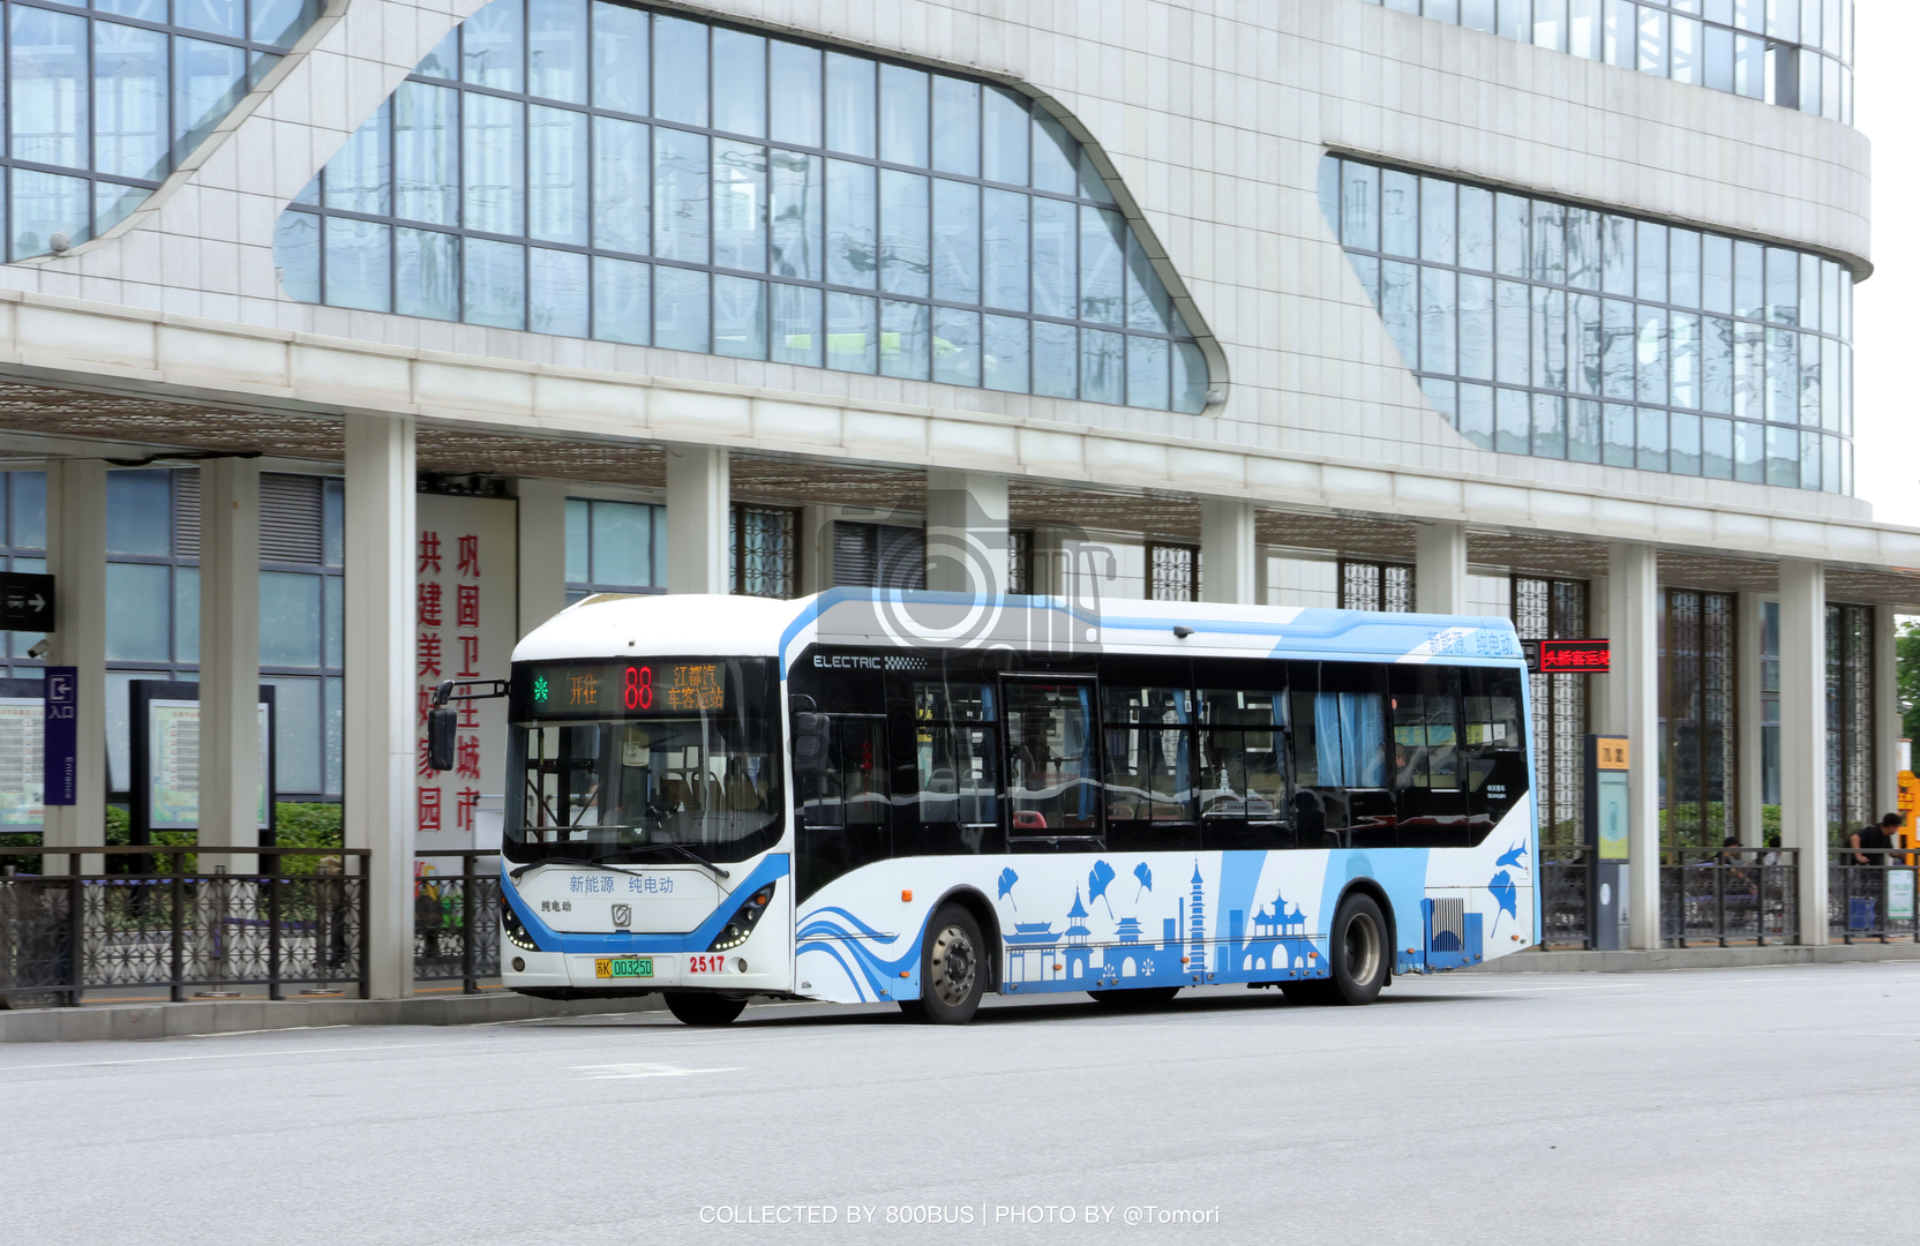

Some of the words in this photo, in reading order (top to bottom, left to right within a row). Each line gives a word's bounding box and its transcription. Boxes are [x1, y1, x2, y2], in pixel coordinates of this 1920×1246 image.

[813, 655, 882, 669] ELECTRIC
[456, 532, 481, 832] 巩固卫生城市
[673, 664, 717, 688] 江都汽
[624, 666, 653, 710] 88
[667, 686, 724, 711] 车客运站
[48, 705, 75, 719] 入口
[569, 875, 615, 894] 新能源
[628, 876, 674, 894] 纯电动
[541, 900, 571, 913] 纯电动
[690, 956, 725, 973] 2517
